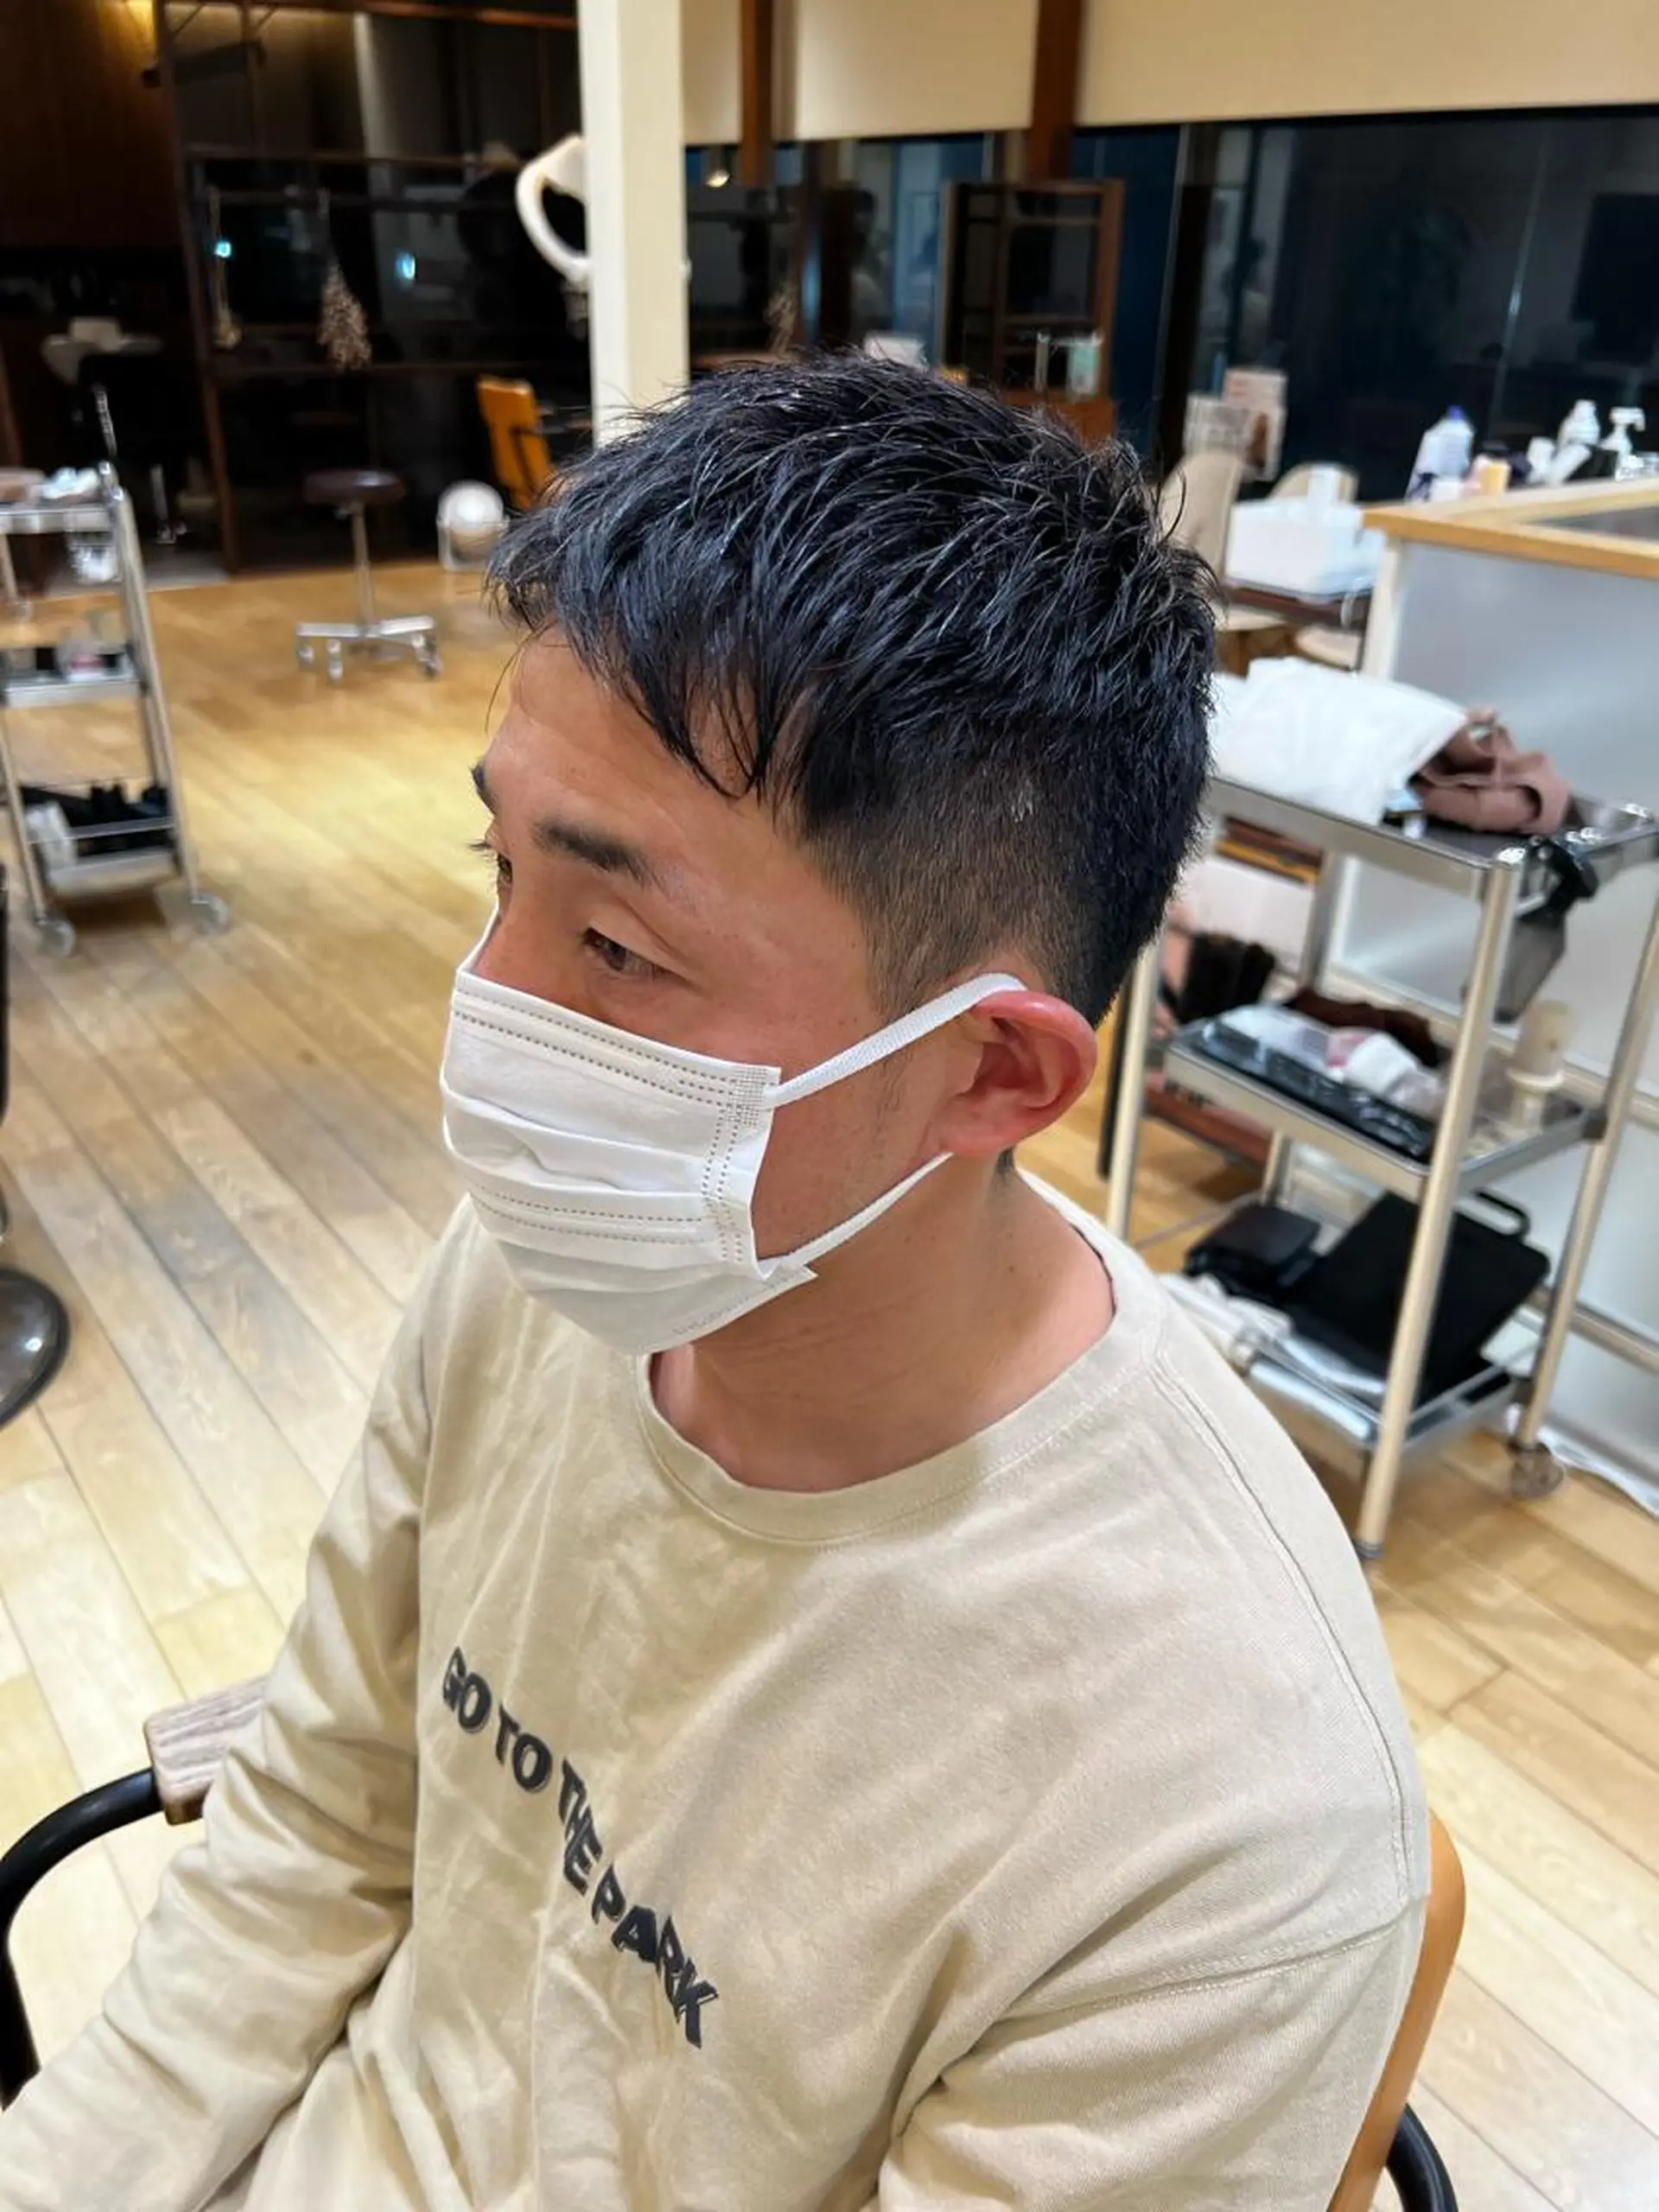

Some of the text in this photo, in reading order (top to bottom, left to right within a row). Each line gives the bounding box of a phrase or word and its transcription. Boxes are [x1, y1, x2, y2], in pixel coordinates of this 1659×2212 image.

[442, 1646, 719, 2049] GO TO THE PARK
